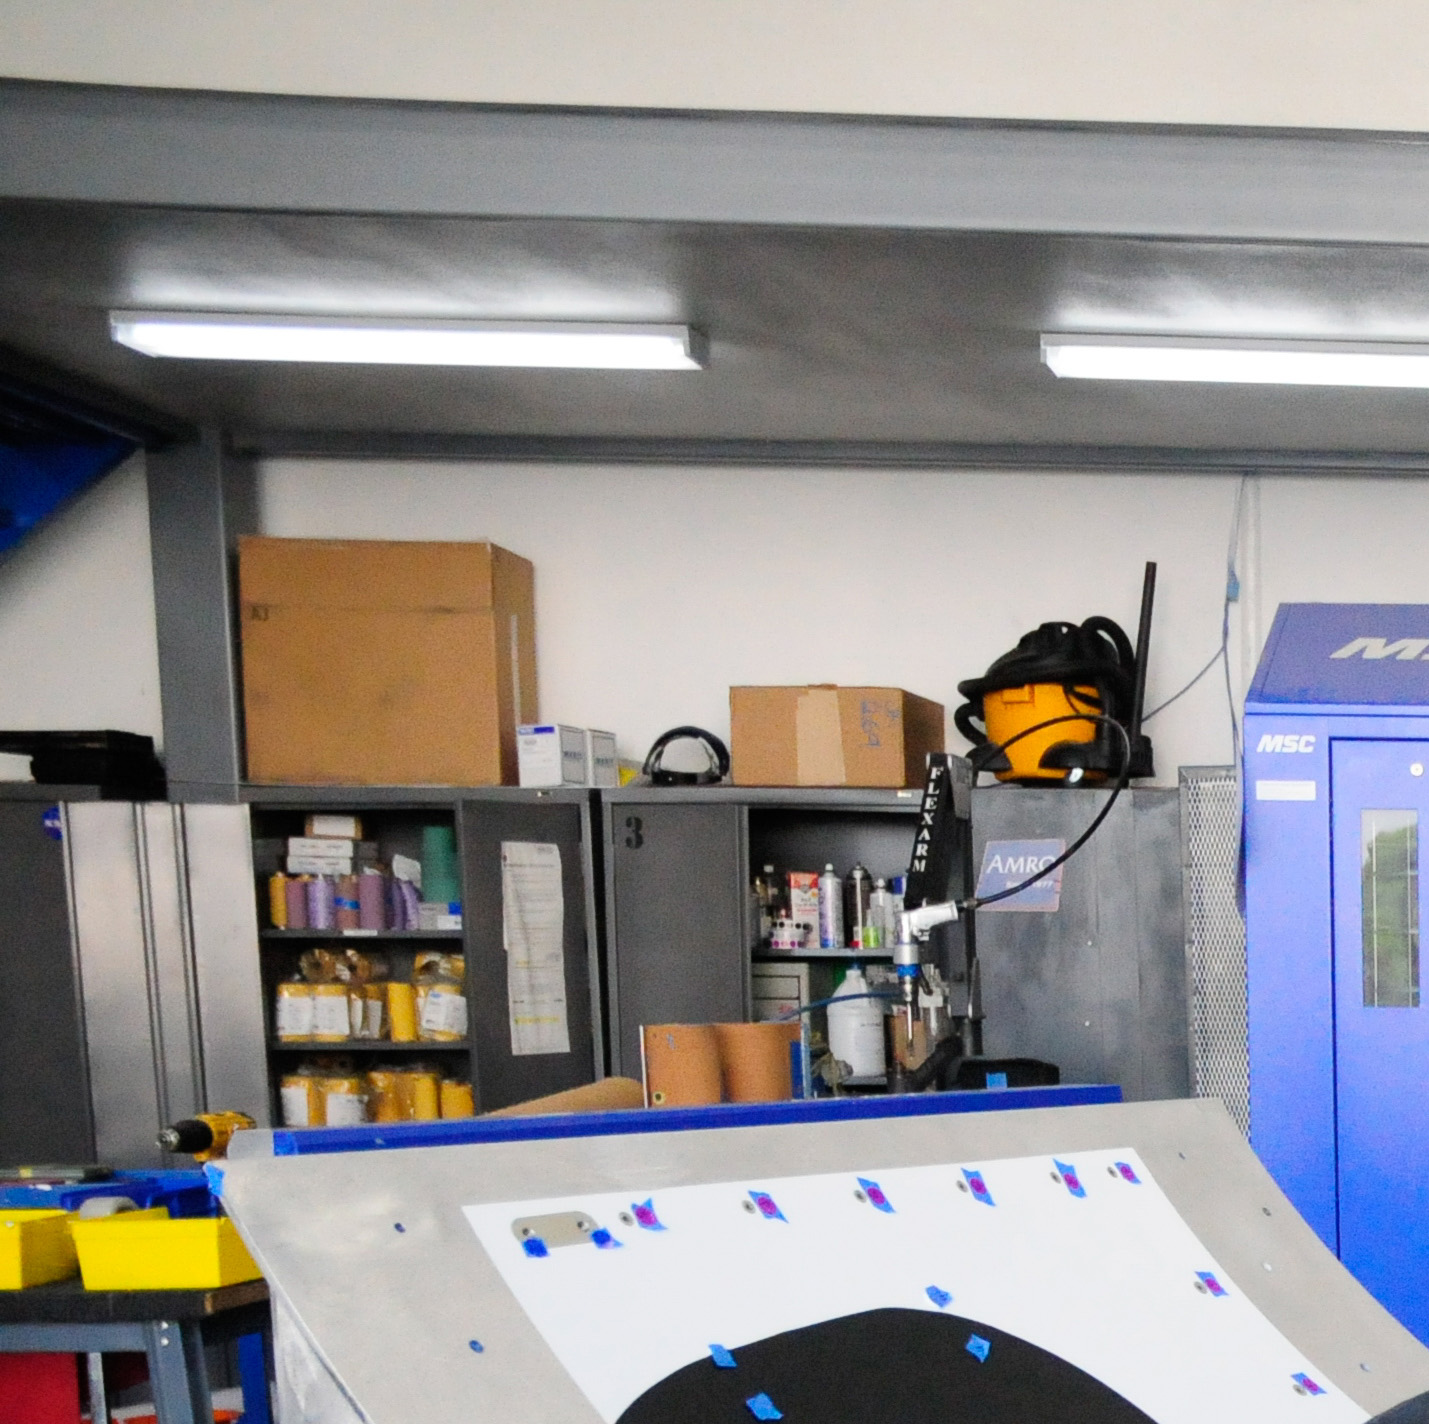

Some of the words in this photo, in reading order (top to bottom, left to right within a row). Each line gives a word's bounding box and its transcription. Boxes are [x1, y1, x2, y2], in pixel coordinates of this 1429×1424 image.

[1257, 734, 1316, 753] MSC
[626, 816, 643, 849] 3
[912, 766, 944, 873] FLEXARM
